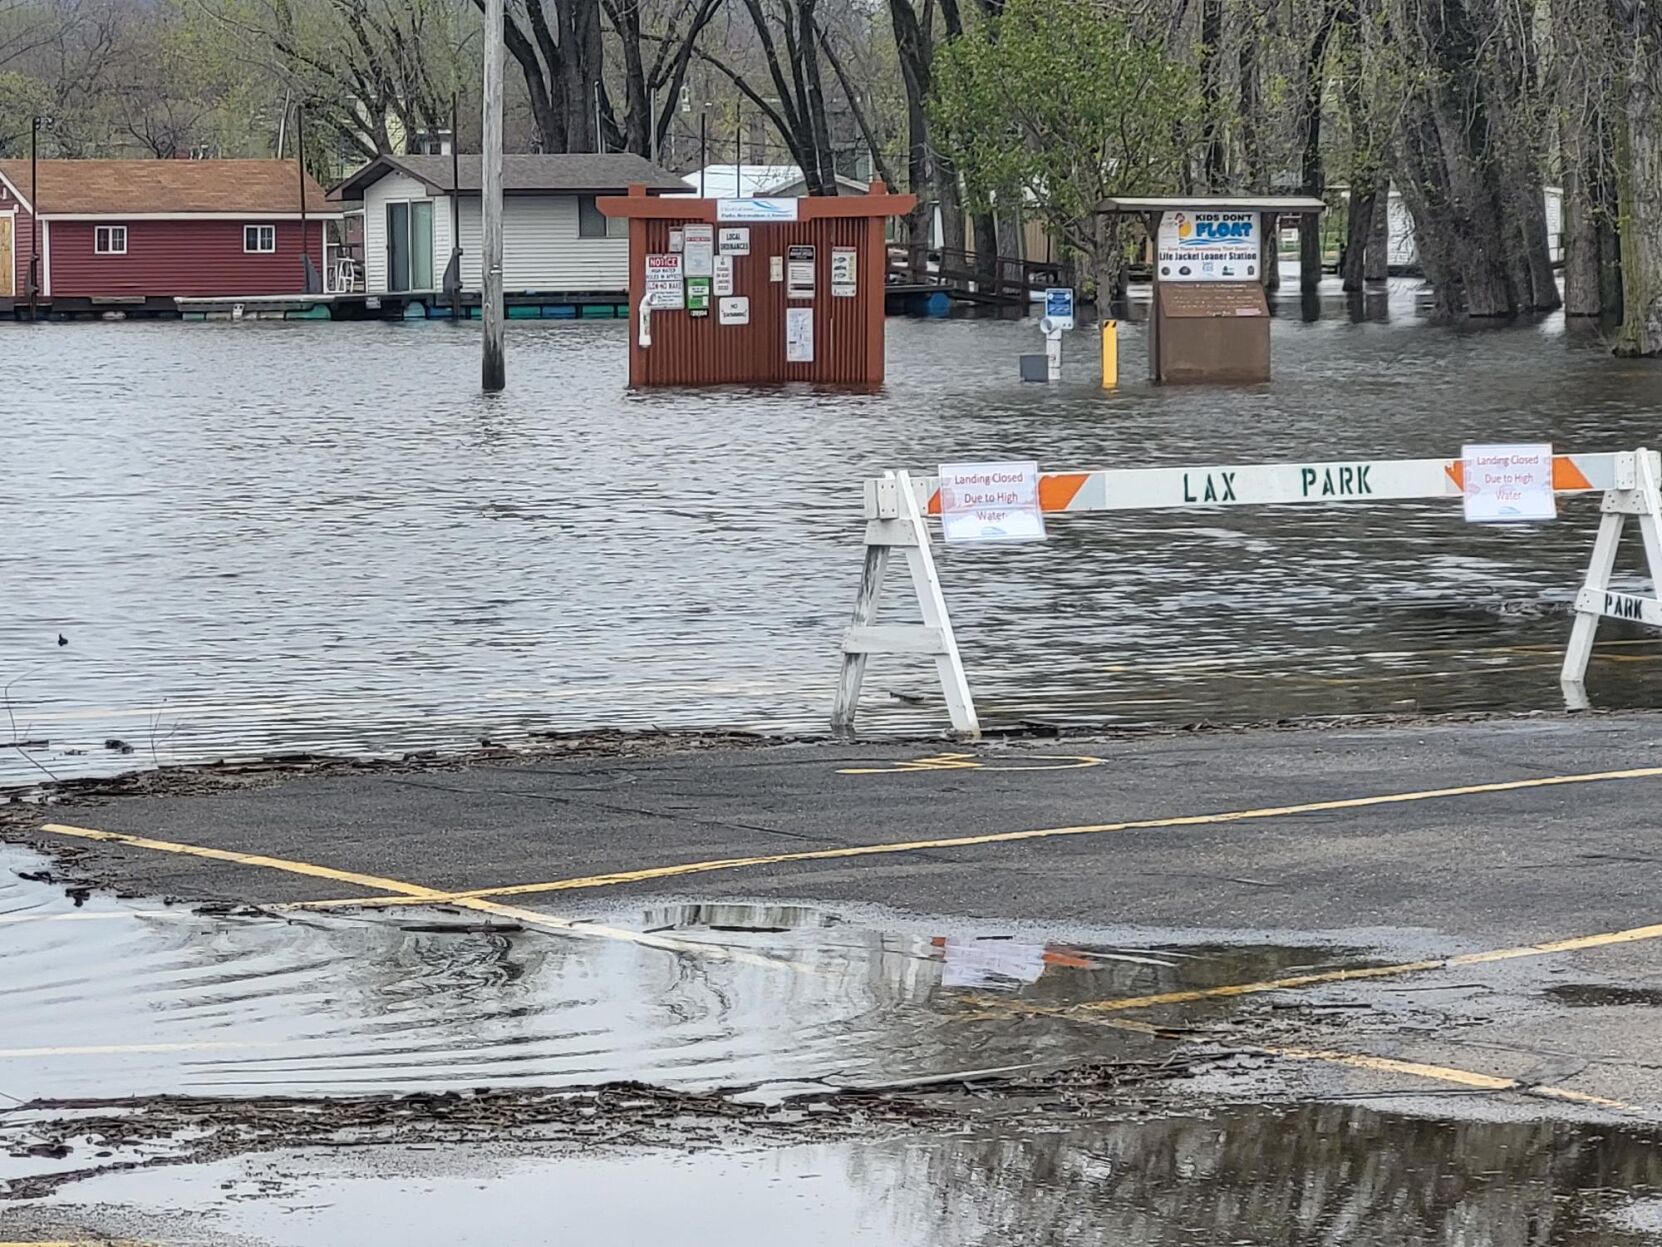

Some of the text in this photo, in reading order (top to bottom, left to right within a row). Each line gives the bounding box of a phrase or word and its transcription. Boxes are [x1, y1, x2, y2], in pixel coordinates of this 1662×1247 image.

[1196, 222, 1253, 238] FLOAT
[650, 257, 677, 267] NOTICE
[1160, 252, 1257, 260] Life Jacket Loaner Station
[1477, 455, 1539, 467] Landing Closed
[955, 472, 1024, 486] Landing Closed
[1183, 465, 1372, 502] LAX PARK
[1485, 473, 1533, 484] Due to High
[964, 491, 1018, 504] Due to High
[1496, 491, 1522, 500] Water
[976, 511, 1006, 521] Water
[1604, 592, 1643, 620] PARK
